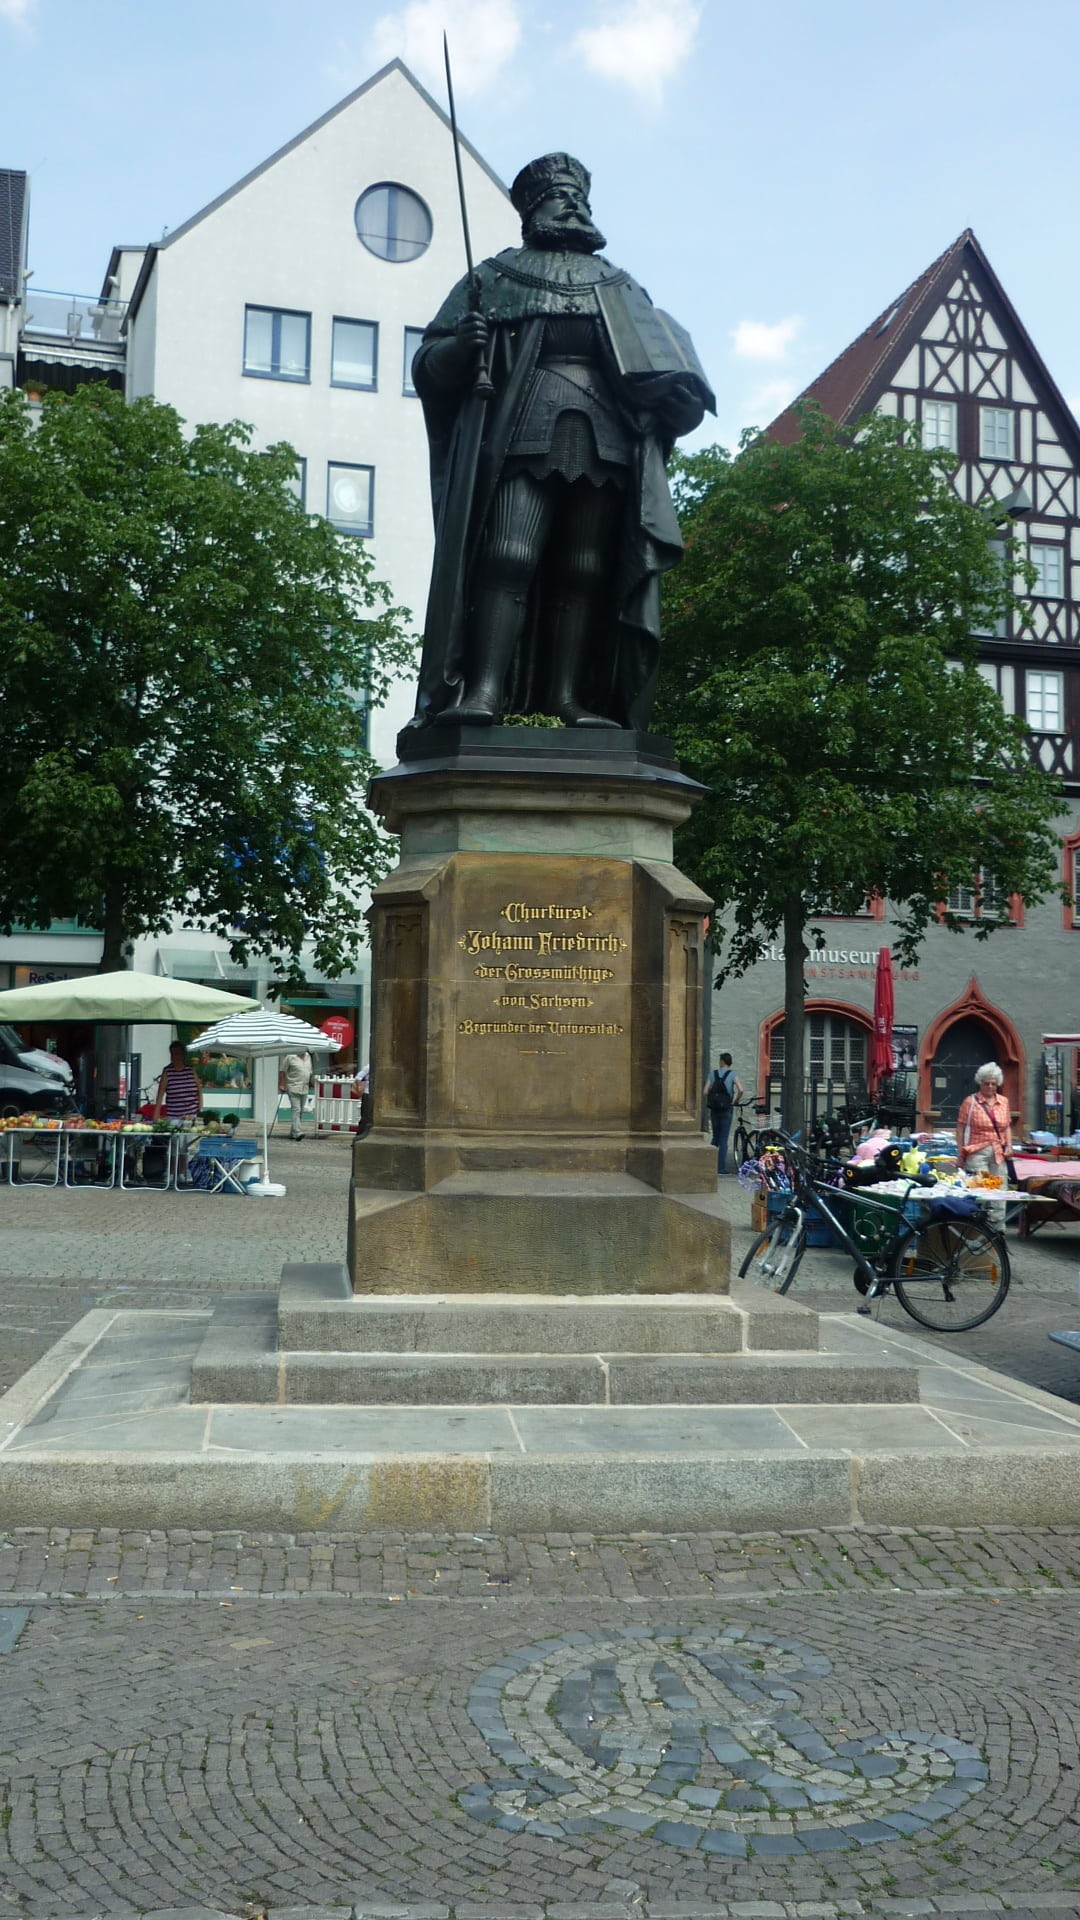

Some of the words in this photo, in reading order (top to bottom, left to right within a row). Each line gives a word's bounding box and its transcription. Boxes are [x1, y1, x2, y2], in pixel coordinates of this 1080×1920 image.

[505, 902, 588, 923] Churfürst
[467, 930, 533, 955] Johann
[536, 932, 617, 956] Friedrich
[757, 942, 880, 964] Stamuseu
[479, 962, 503, 978] der
[504, 963, 609, 984] Grossmüthige
[502, 996, 525, 1006] von
[527, 994, 587, 1010] Sachsen
[464, 1019, 525, 1034] Begründer
[528, 1021, 546, 1033] der
